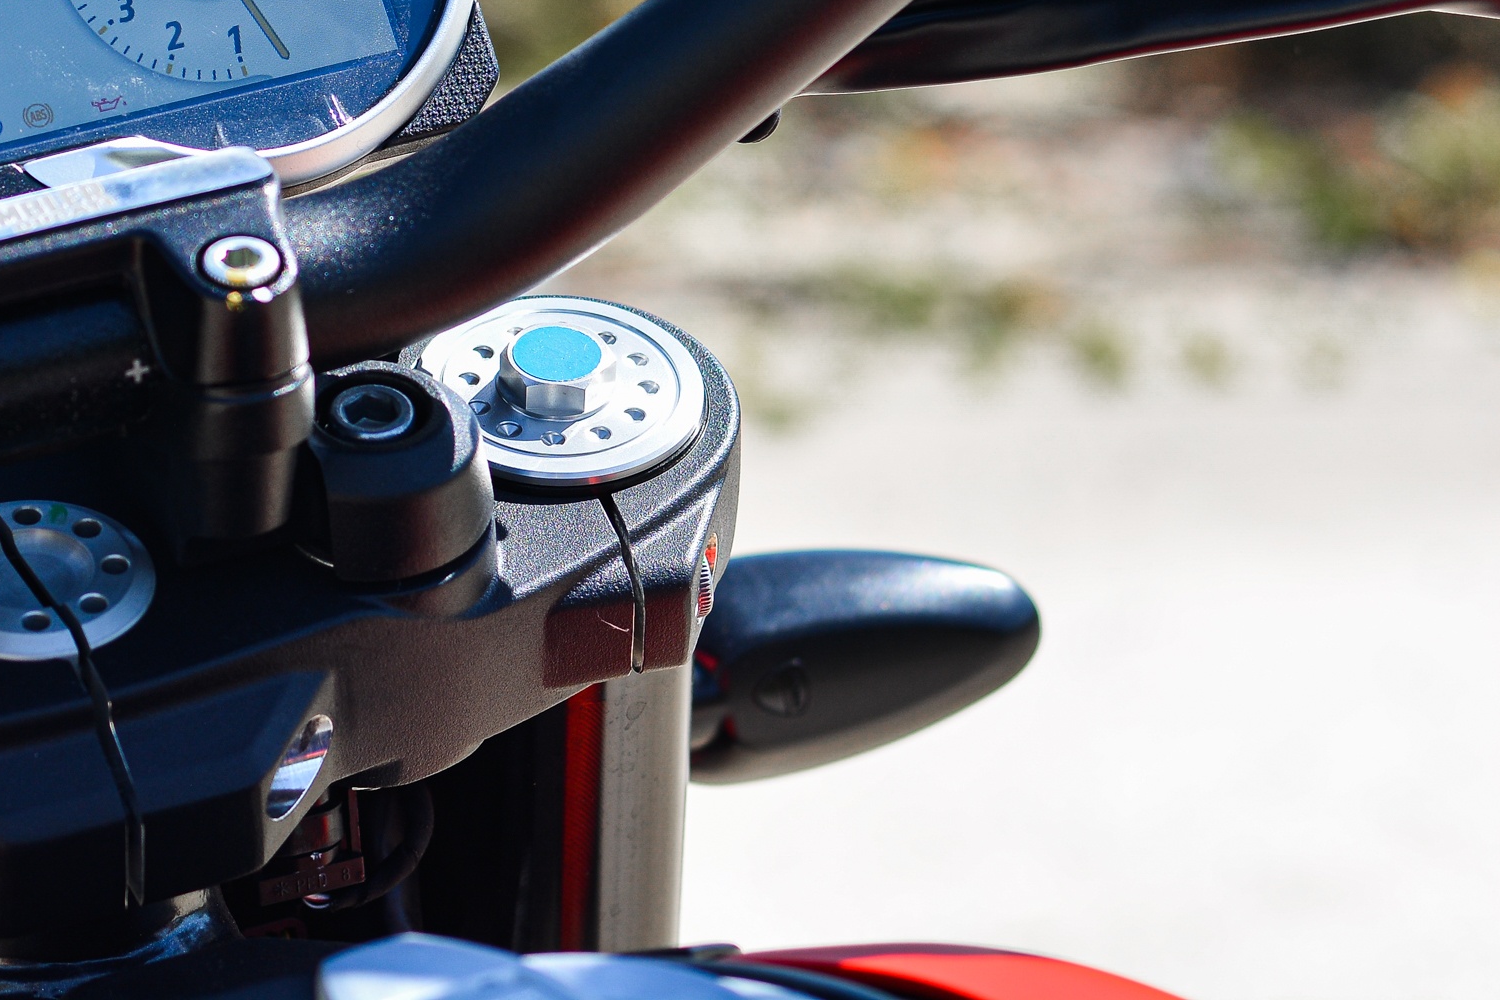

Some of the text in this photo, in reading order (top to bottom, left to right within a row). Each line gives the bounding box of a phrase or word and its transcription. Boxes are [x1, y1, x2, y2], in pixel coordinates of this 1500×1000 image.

[165, 20, 185, 51] 2
[227, 25, 242, 54] 1
[30, 109, 47, 122] ABS
[342, 867, 352, 882] 8
